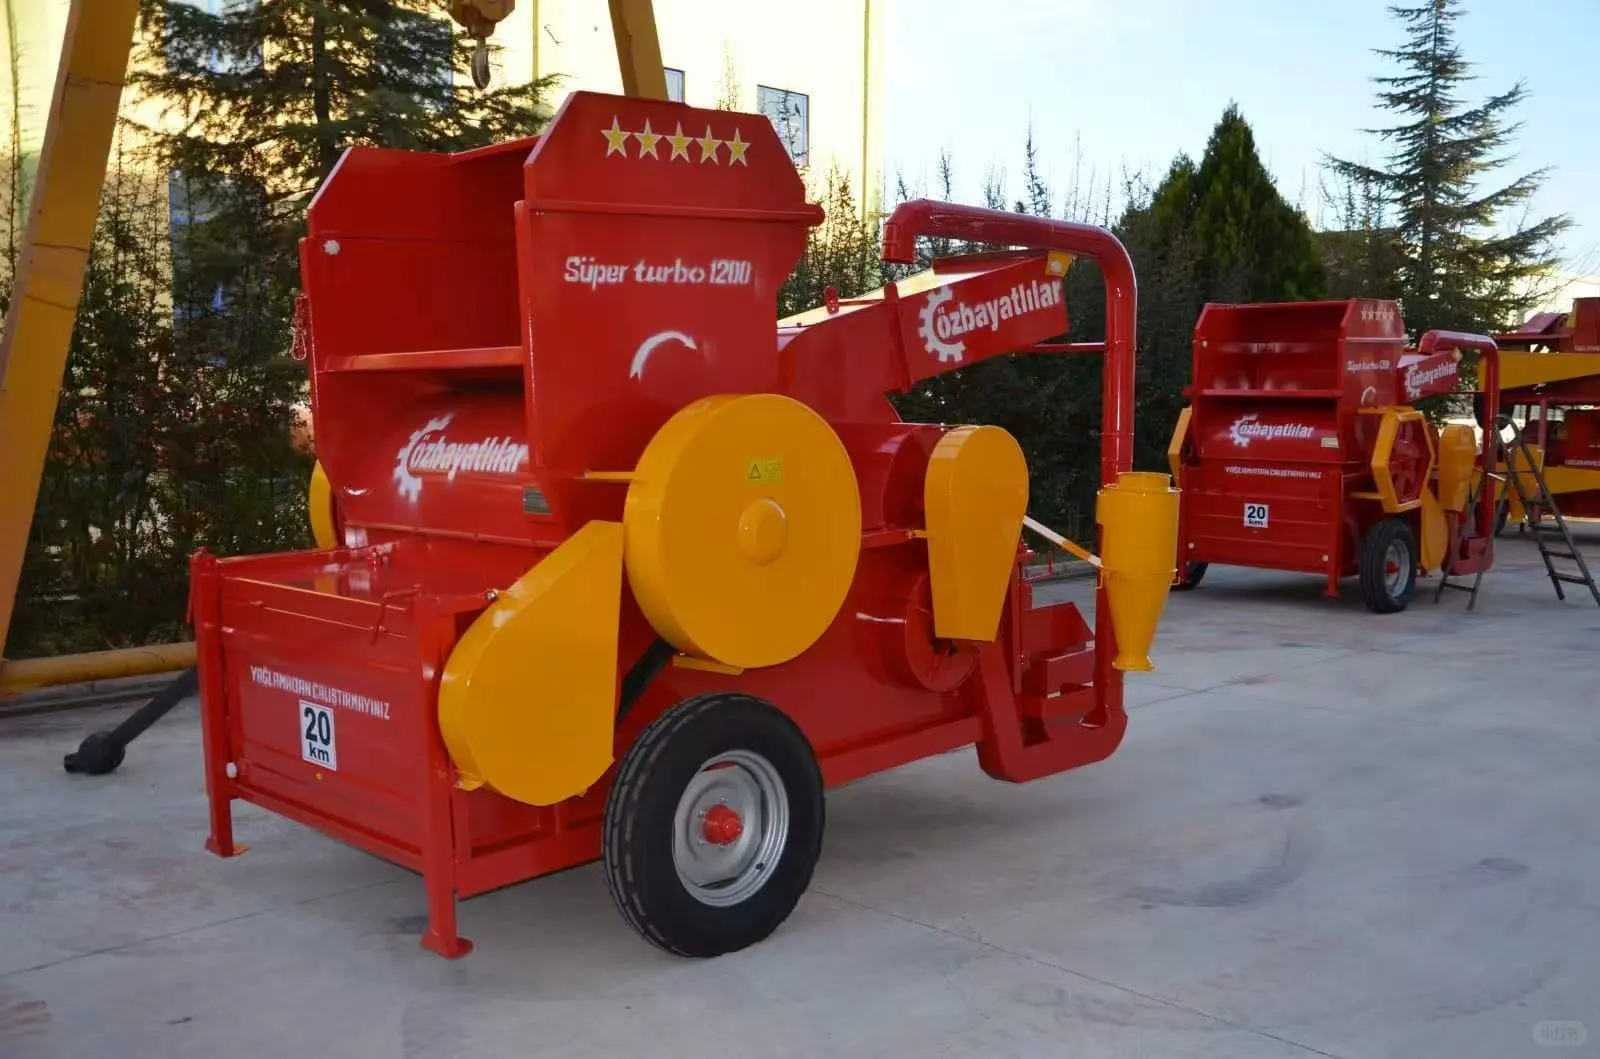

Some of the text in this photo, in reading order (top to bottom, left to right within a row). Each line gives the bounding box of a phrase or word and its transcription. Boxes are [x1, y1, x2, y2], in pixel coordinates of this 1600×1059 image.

[564, 256, 752, 291] Süper turbo 1200
[1247, 506, 1266, 519] 20
[304, 707, 331, 746] 20
[309, 741, 329, 762] km
